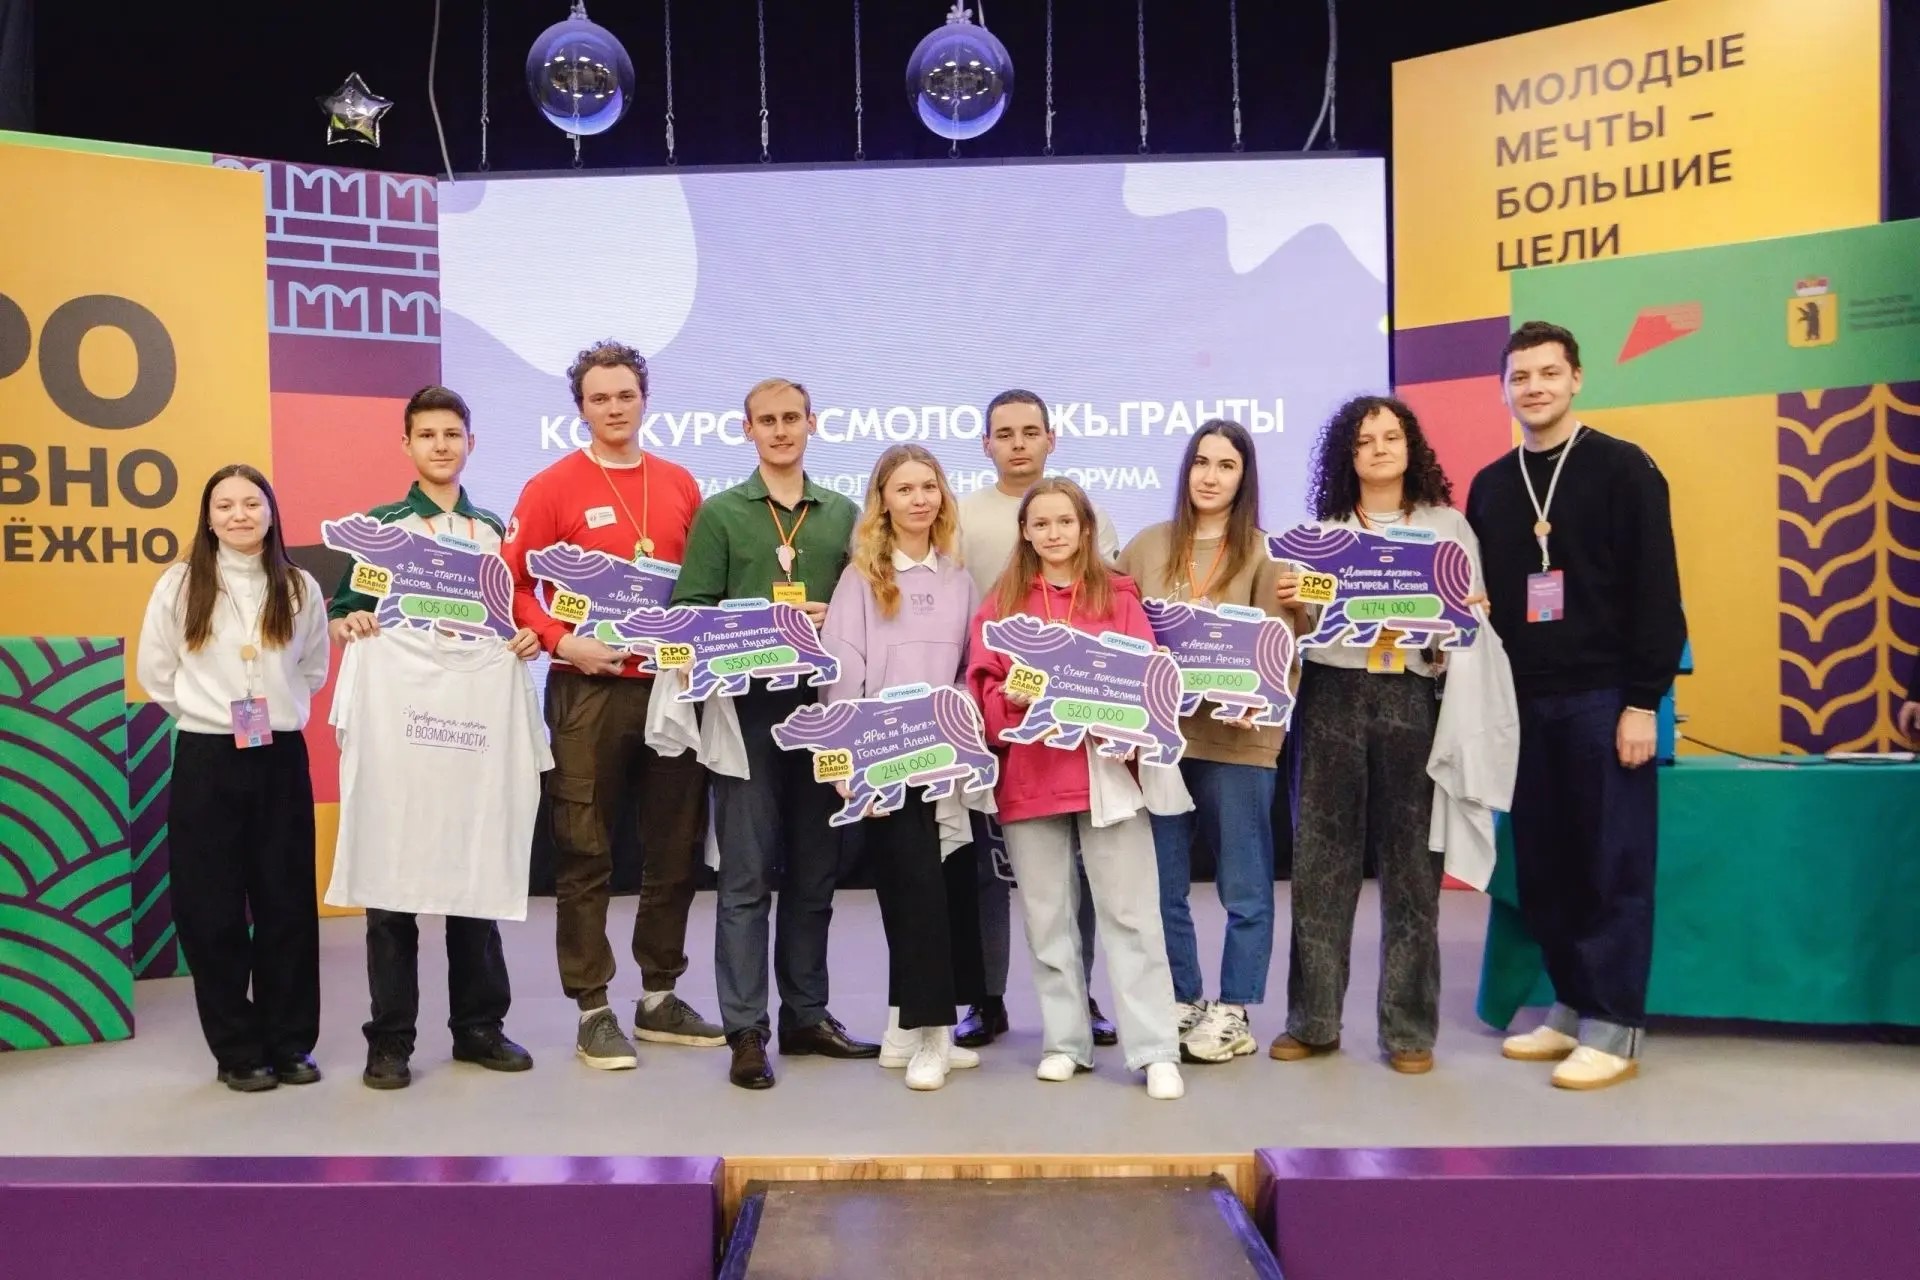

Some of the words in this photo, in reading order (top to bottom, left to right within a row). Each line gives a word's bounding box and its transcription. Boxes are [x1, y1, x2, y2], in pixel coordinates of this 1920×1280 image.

[1494, 32, 1746, 115] МОЛОДЫЕ
[1495, 105, 1666, 168] МЕЧТЫ
[1496, 149, 1734, 220] БОЛЬШИЕ
[1496, 223, 1621, 272] ЦЕЛИ
[540, 410, 746, 450] КОКУРС
[441, 536, 477, 550] СЕРТИФИКАТ
[359, 567, 388, 583] ЯРО
[642, 562, 678, 575] СЕРТИФИКАТ
[357, 577, 387, 590] СЛАВНО
[1303, 576, 1332, 590] ЯРО
[1301, 587, 1331, 596] СЛАВНО
[418, 600, 440, 614] 105
[444, 604, 469, 618] 000
[559, 595, 586, 610] ЯРО
[1361, 601, 1385, 615] 474
[1391, 601, 1416, 614] 000
[556, 605, 584, 616] СЛАВНО
[1107, 637, 1145, 650] СЕРТИФИКАТ
[660, 647, 690, 656] ЯРО
[725, 655, 750, 671] 550
[753, 652, 779, 666] 000
[1014, 669, 1044, 685] ЯРО
[1188, 673, 1212, 686] 360
[1216, 675, 1243, 687] 000
[887, 687, 925, 698] СЕРТИФИКАТ
[1011, 679, 1041, 692] СЛАВНО
[1067, 704, 1092, 719] 520
[1097, 707, 1125, 722] 000
[415, 725, 487, 748] ВОЗМОЖНОСТИ
[818, 753, 848, 767] ЯРО
[881, 763, 906, 780] 244
[911, 752, 937, 770] 000
[819, 765, 849, 773] СЛАВНО
